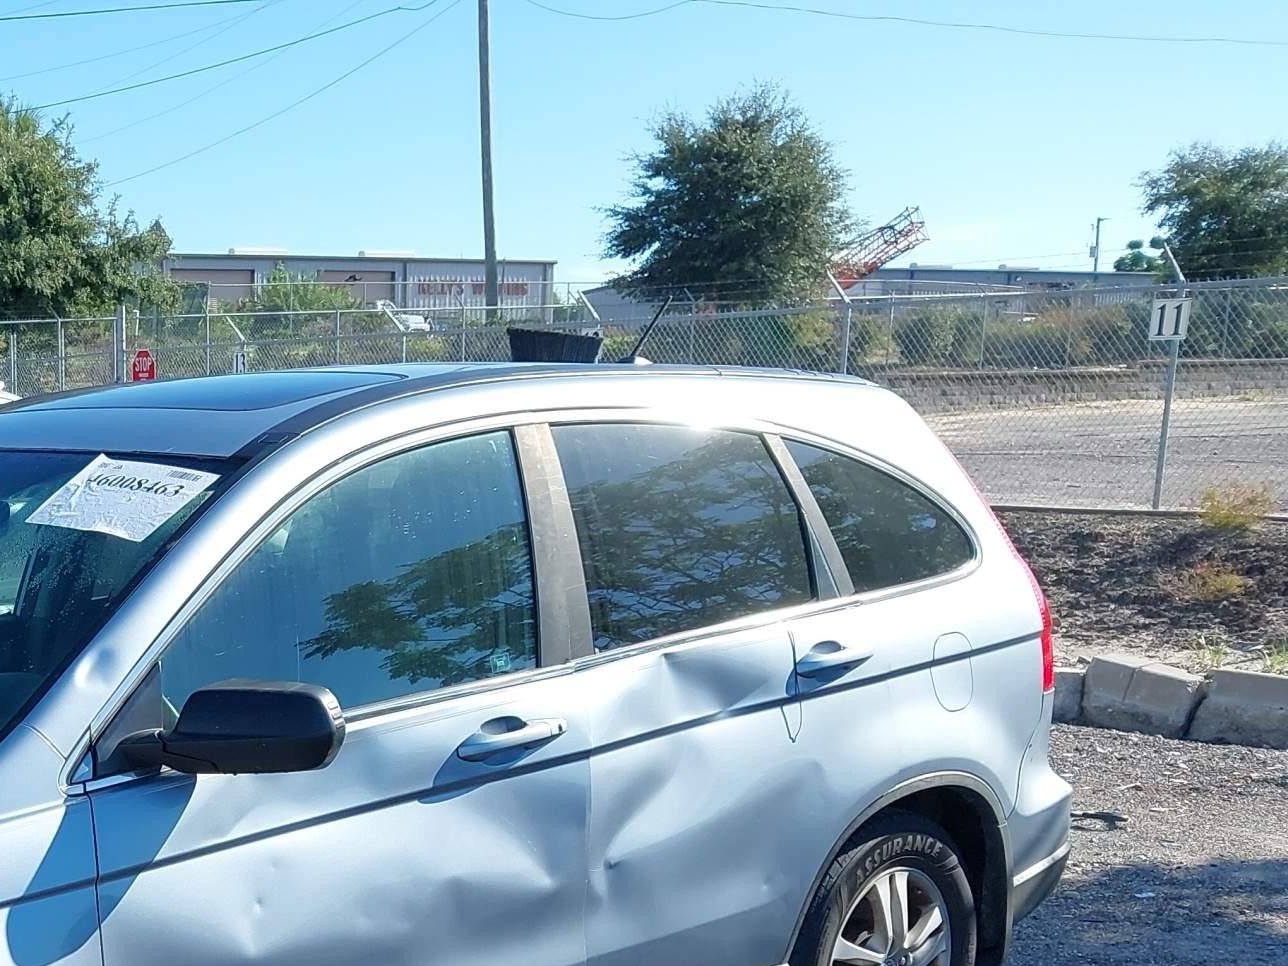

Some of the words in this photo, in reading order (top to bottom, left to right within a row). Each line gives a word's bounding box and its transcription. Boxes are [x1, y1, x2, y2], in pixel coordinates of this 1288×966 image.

[1152, 303, 1183, 336] 11
[134, 356, 152, 372] STOP
[235, 353, 246, 373] 13
[856, 832, 943, 884] ASSURANCE
